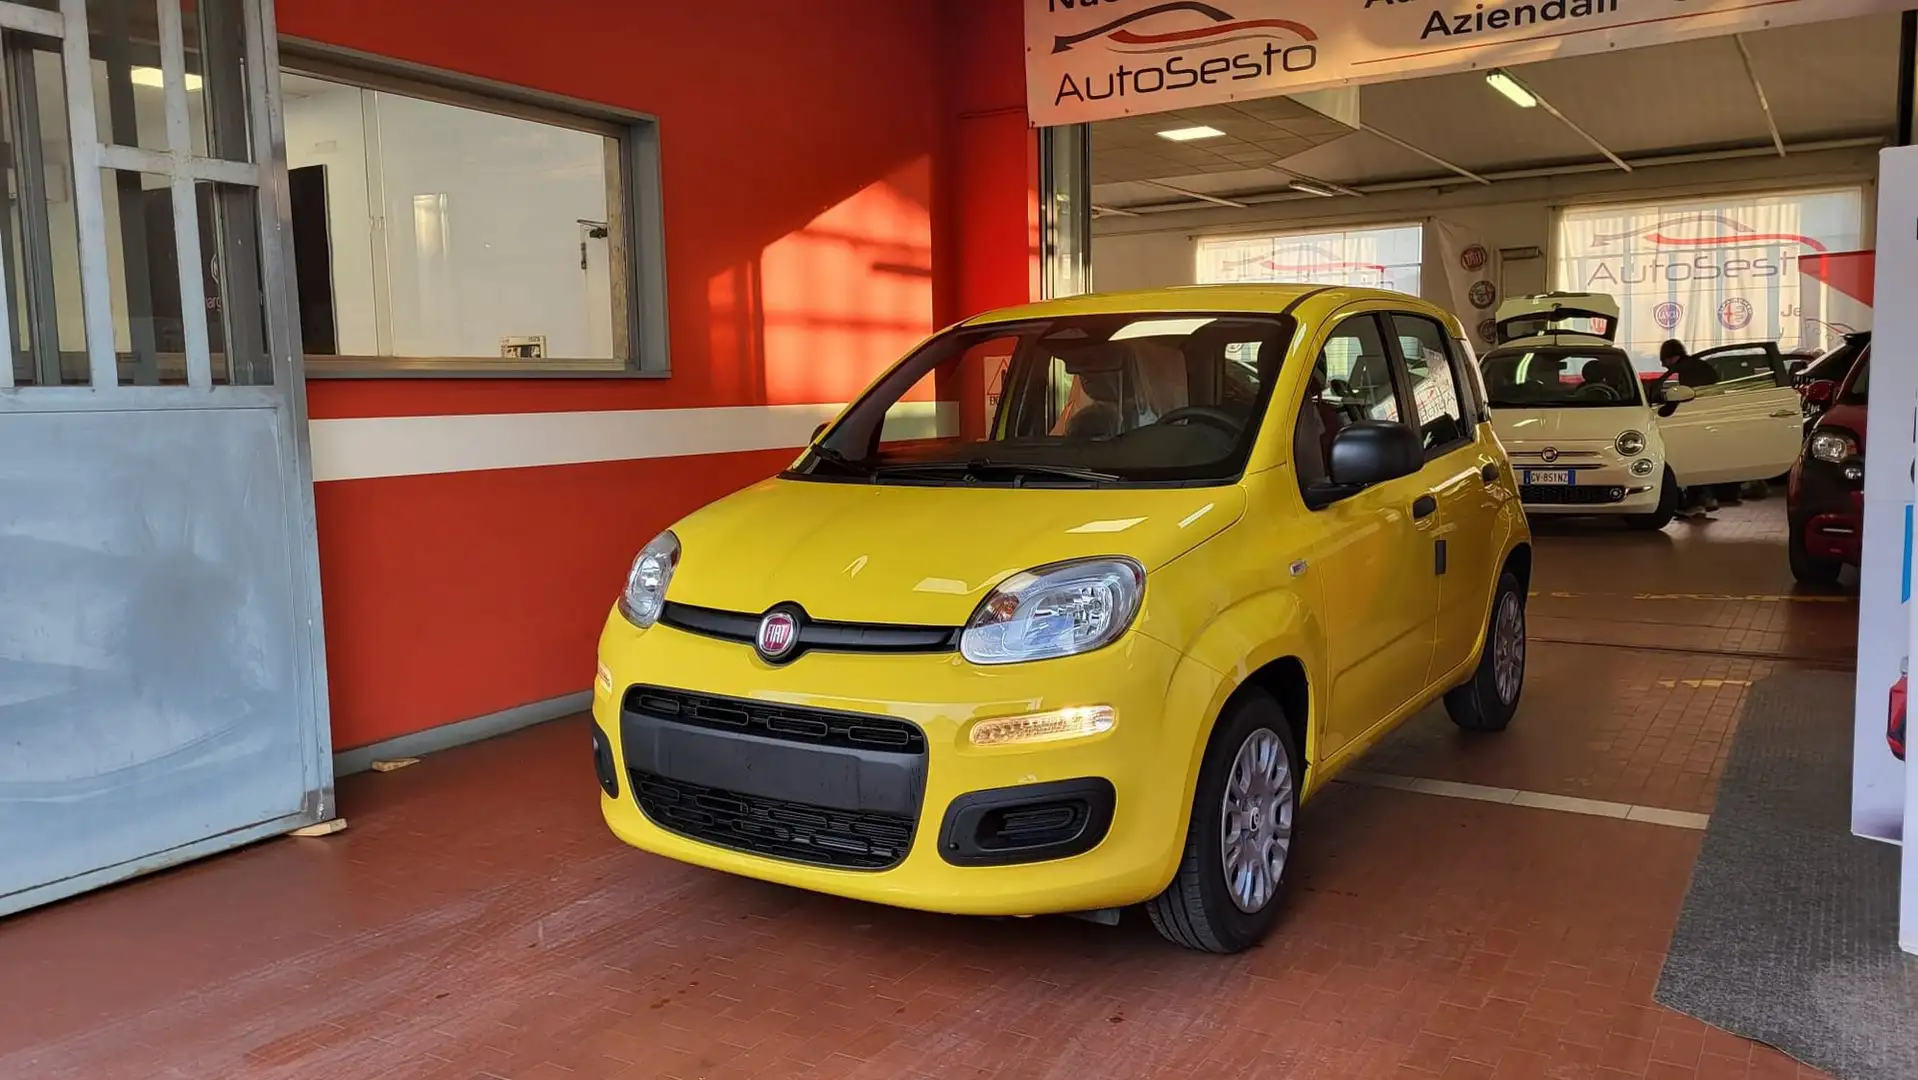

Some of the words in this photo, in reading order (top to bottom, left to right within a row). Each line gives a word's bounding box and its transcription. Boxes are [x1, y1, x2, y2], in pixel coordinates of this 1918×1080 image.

[1055, 42, 1317, 106] AutoSesto
[1588, 251, 1798, 286] AutoSest
[1781, 304, 1802, 318] Je
[765, 623, 790, 643] FIAT
